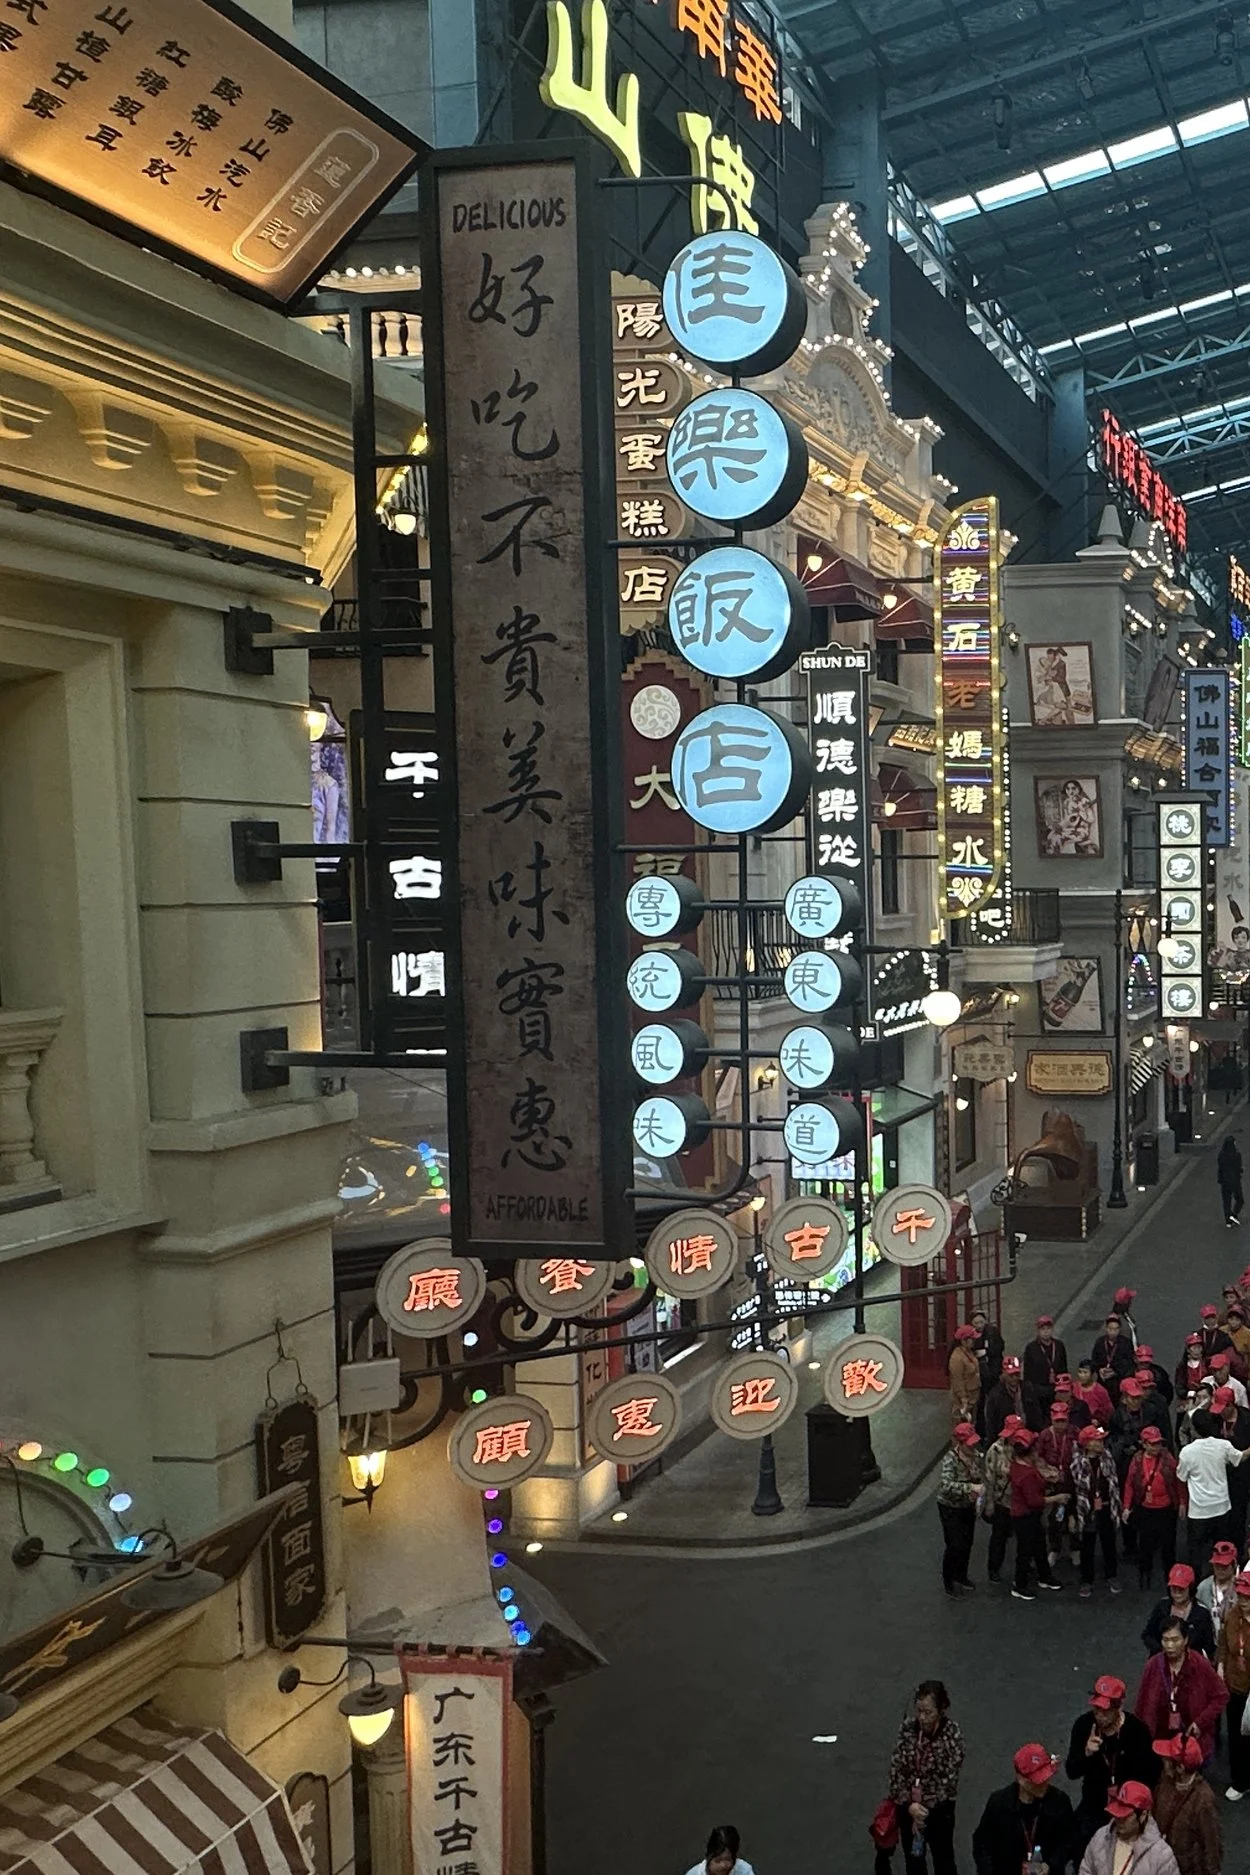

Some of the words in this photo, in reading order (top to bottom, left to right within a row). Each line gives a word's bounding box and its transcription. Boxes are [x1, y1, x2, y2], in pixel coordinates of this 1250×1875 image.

[22, 4, 134, 121] 山楂甘露
[85, 38, 192, 152] 紅糖銀耳
[141, 76, 245, 186] 酸梅冰飲
[197, 108, 295, 212] 佛山汽水
[452, 197, 567, 235] DELICIOUS
[616, 303, 669, 602] 陽光蛋糕店
[672, 243, 775, 809] 佳樂飯店
[467, 253, 574, 1174] 好吃不貴美味實惠
[803, 656, 842, 669] SHUN
[845, 656, 865, 669] DE
[628, 884, 673, 1147] 傳統風味
[782, 884, 835, 1157] 廣東味道
[485, 1195, 589, 1223] AFFORDABLE
